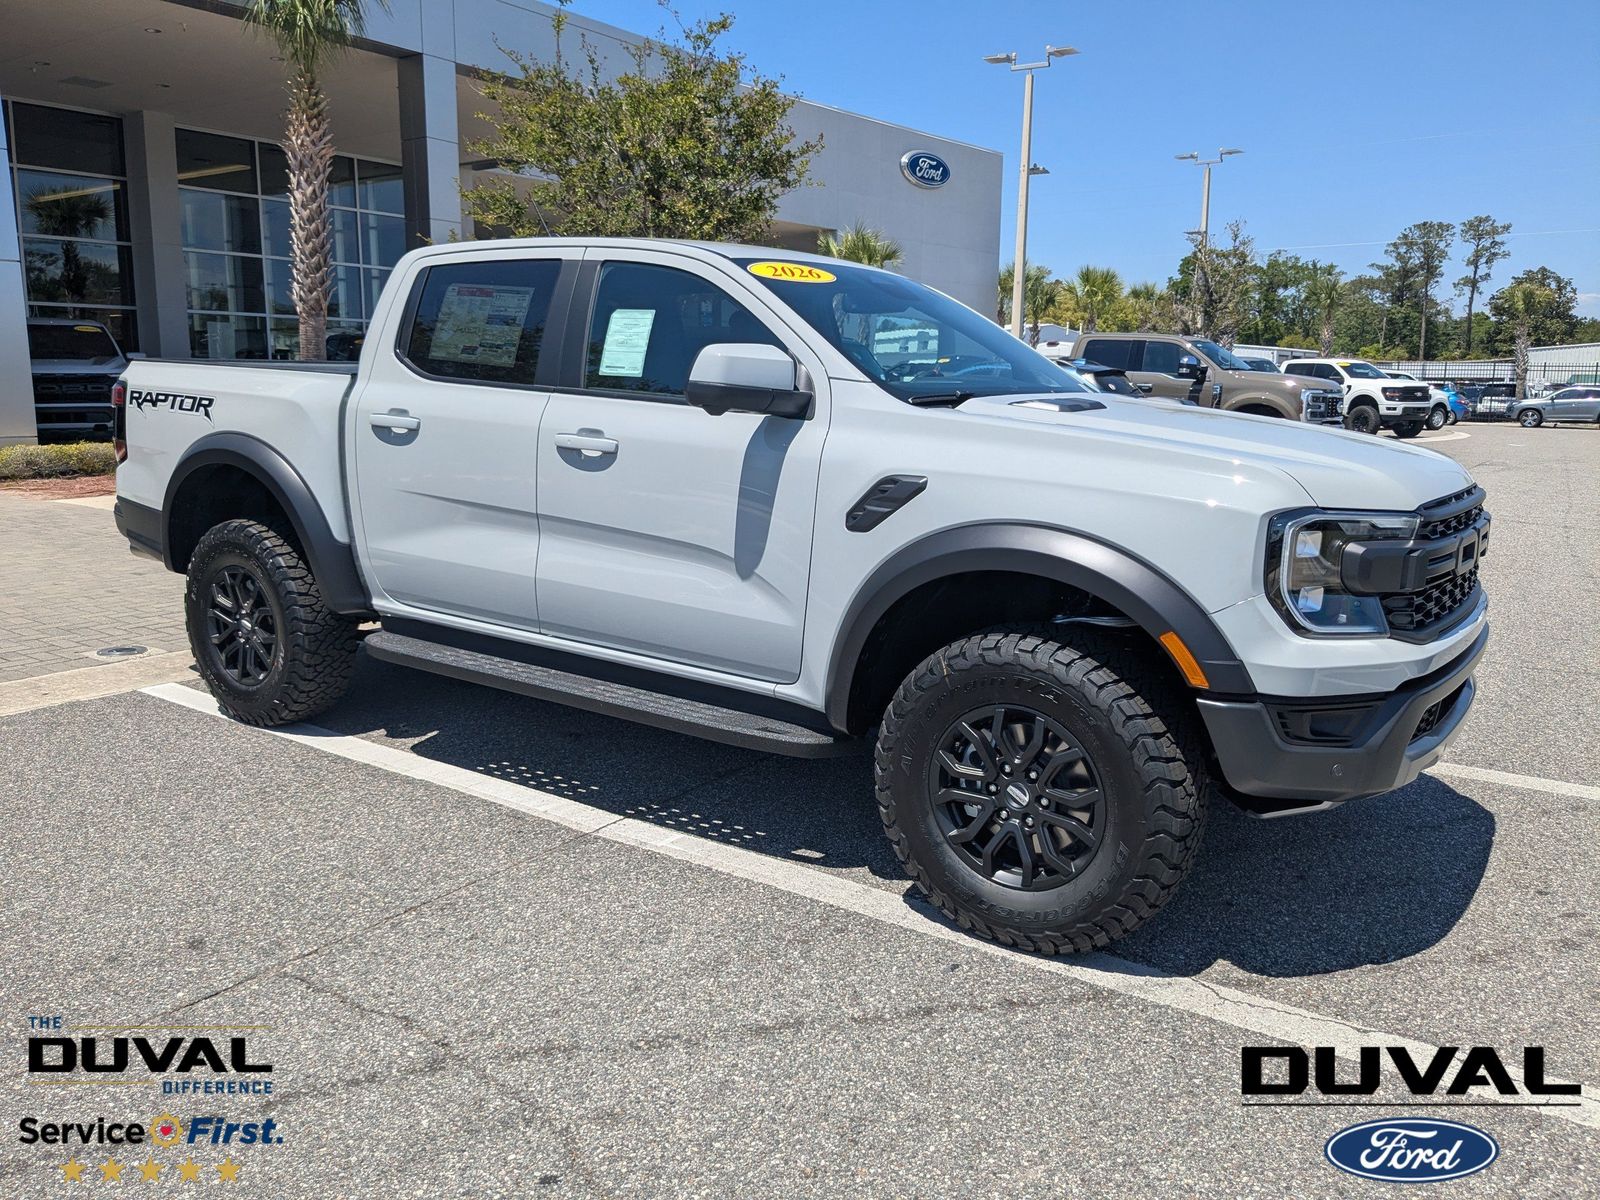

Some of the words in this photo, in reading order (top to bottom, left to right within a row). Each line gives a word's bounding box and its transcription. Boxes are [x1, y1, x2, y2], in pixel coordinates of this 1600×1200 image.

[915, 157, 943, 182] Ford
[766, 264, 822, 280] 2026
[129, 389, 215, 426] RAPTOR
